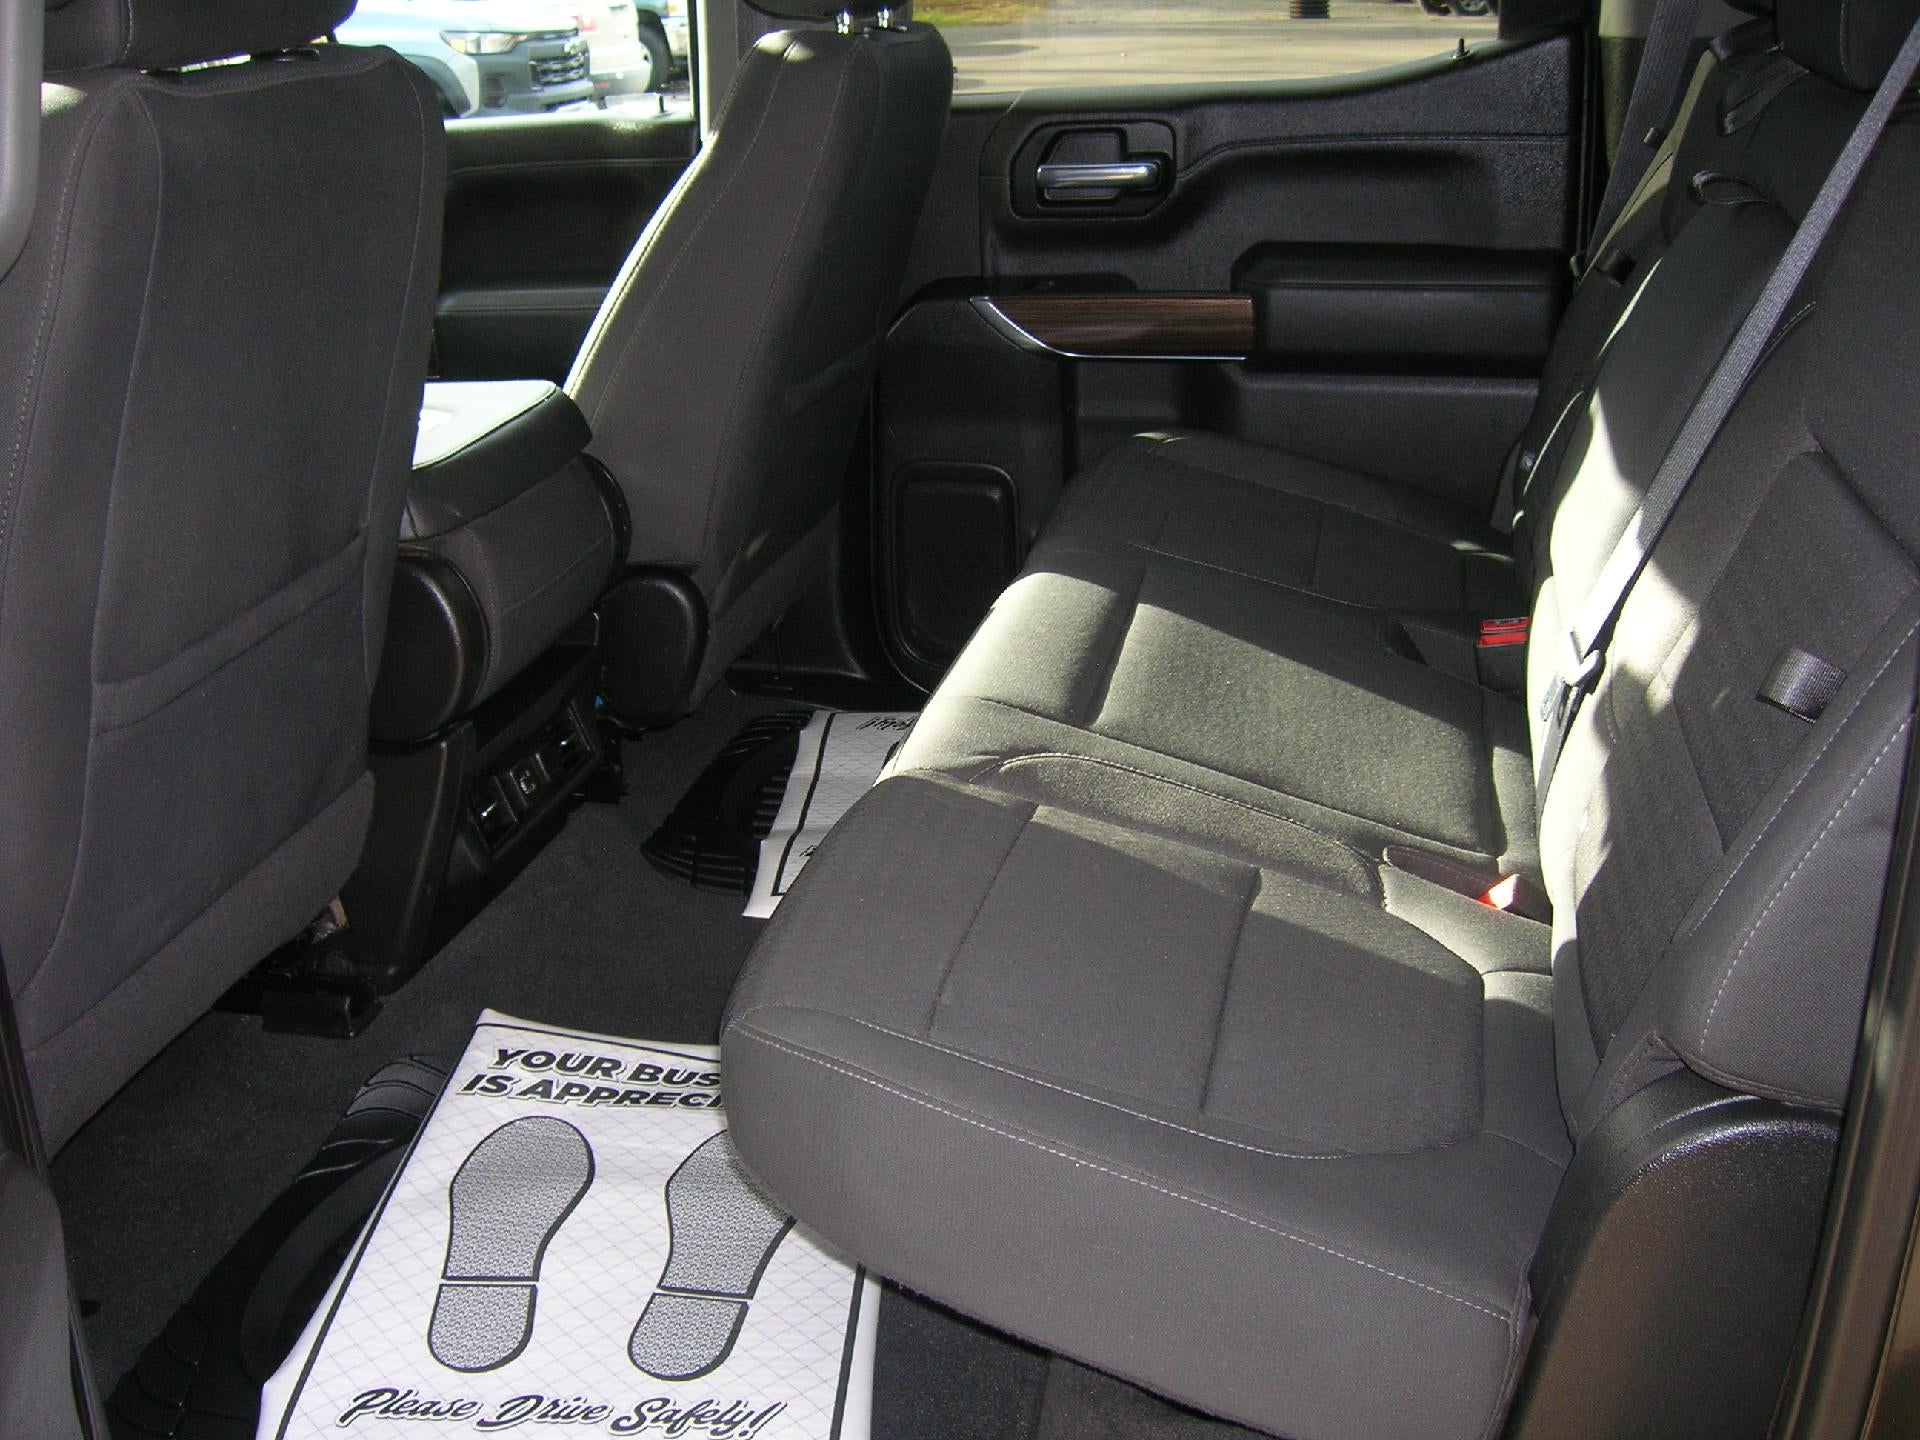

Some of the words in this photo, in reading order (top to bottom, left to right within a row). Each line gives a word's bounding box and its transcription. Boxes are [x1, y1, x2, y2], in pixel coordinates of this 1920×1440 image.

[489, 1048, 625, 1081] YOUR
[458, 1073, 520, 1096] IS
[336, 1386, 482, 1427] Please
[474, 1394, 613, 1431] Drive
